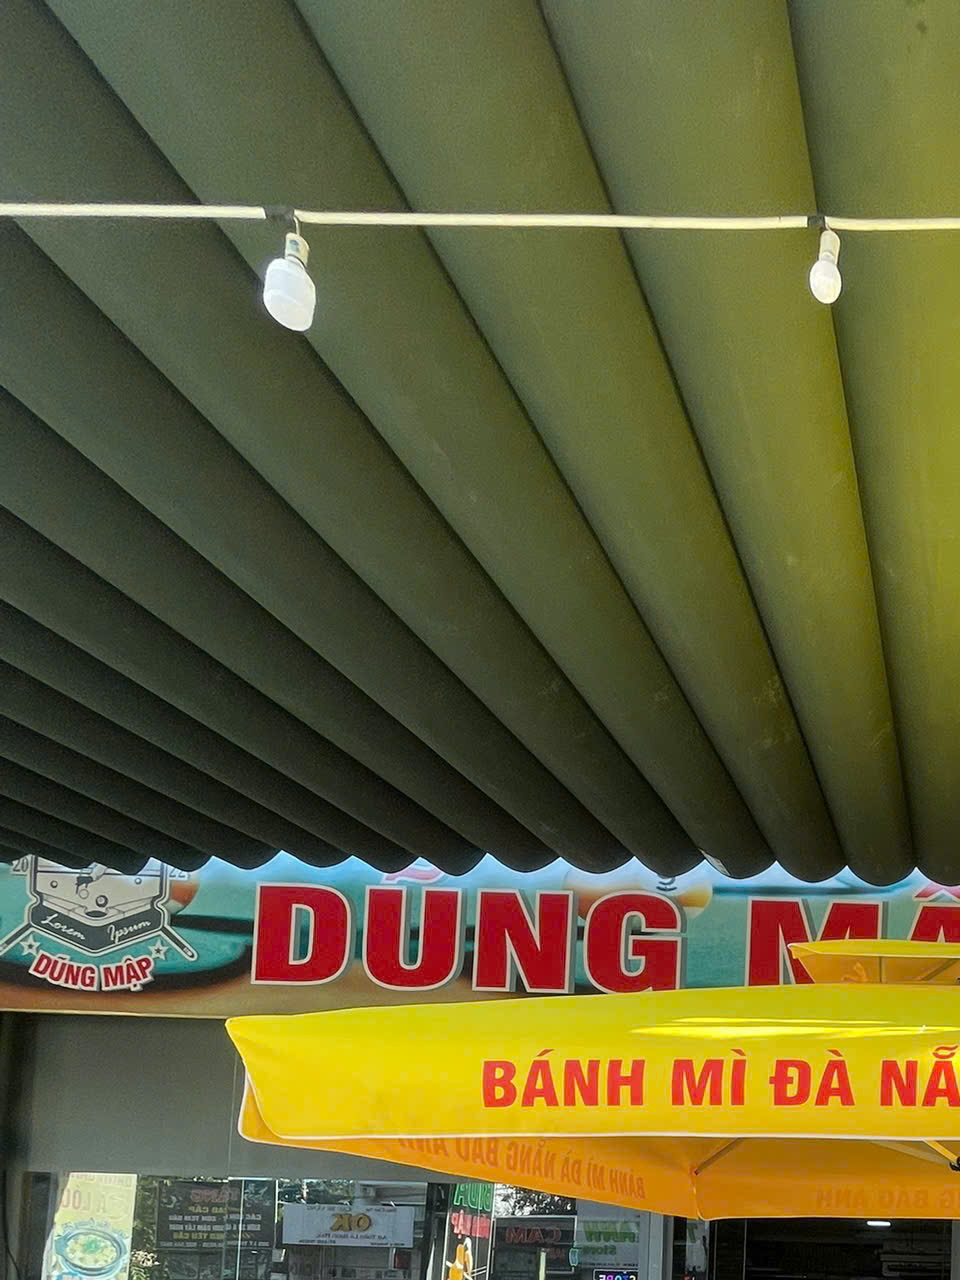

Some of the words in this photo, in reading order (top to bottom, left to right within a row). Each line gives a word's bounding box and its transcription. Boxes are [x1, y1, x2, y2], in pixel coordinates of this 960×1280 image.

[41, 913, 85, 940] Lorem
[107, 920, 151, 944] Ipsum
[32, 953, 96, 988] DŨNG
[103, 956, 153, 989] MẬP
[481, 1049, 646, 1108] BÁNH
[671, 1048, 747, 1107] MÌ
[769, 1048, 856, 1107] ĐÀ
